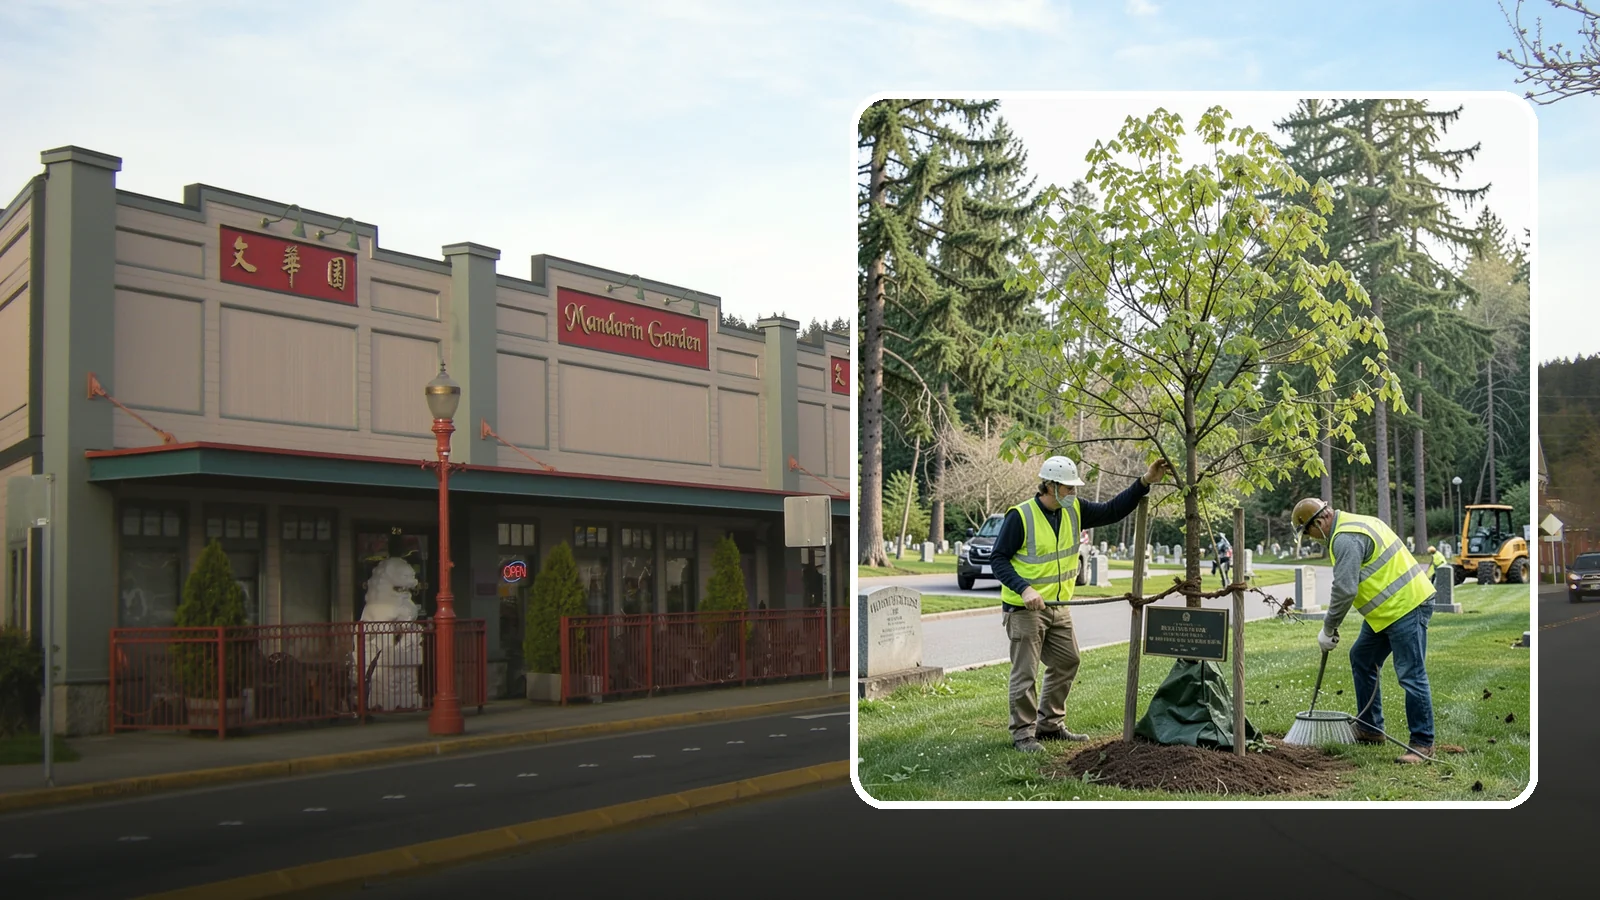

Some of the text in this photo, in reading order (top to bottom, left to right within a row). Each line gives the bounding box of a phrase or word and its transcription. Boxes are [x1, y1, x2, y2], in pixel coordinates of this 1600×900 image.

[231, 236, 346, 290] 文華園
[564, 302, 702, 352] Mandarin Garden
[503, 565, 527, 578] OPEN
